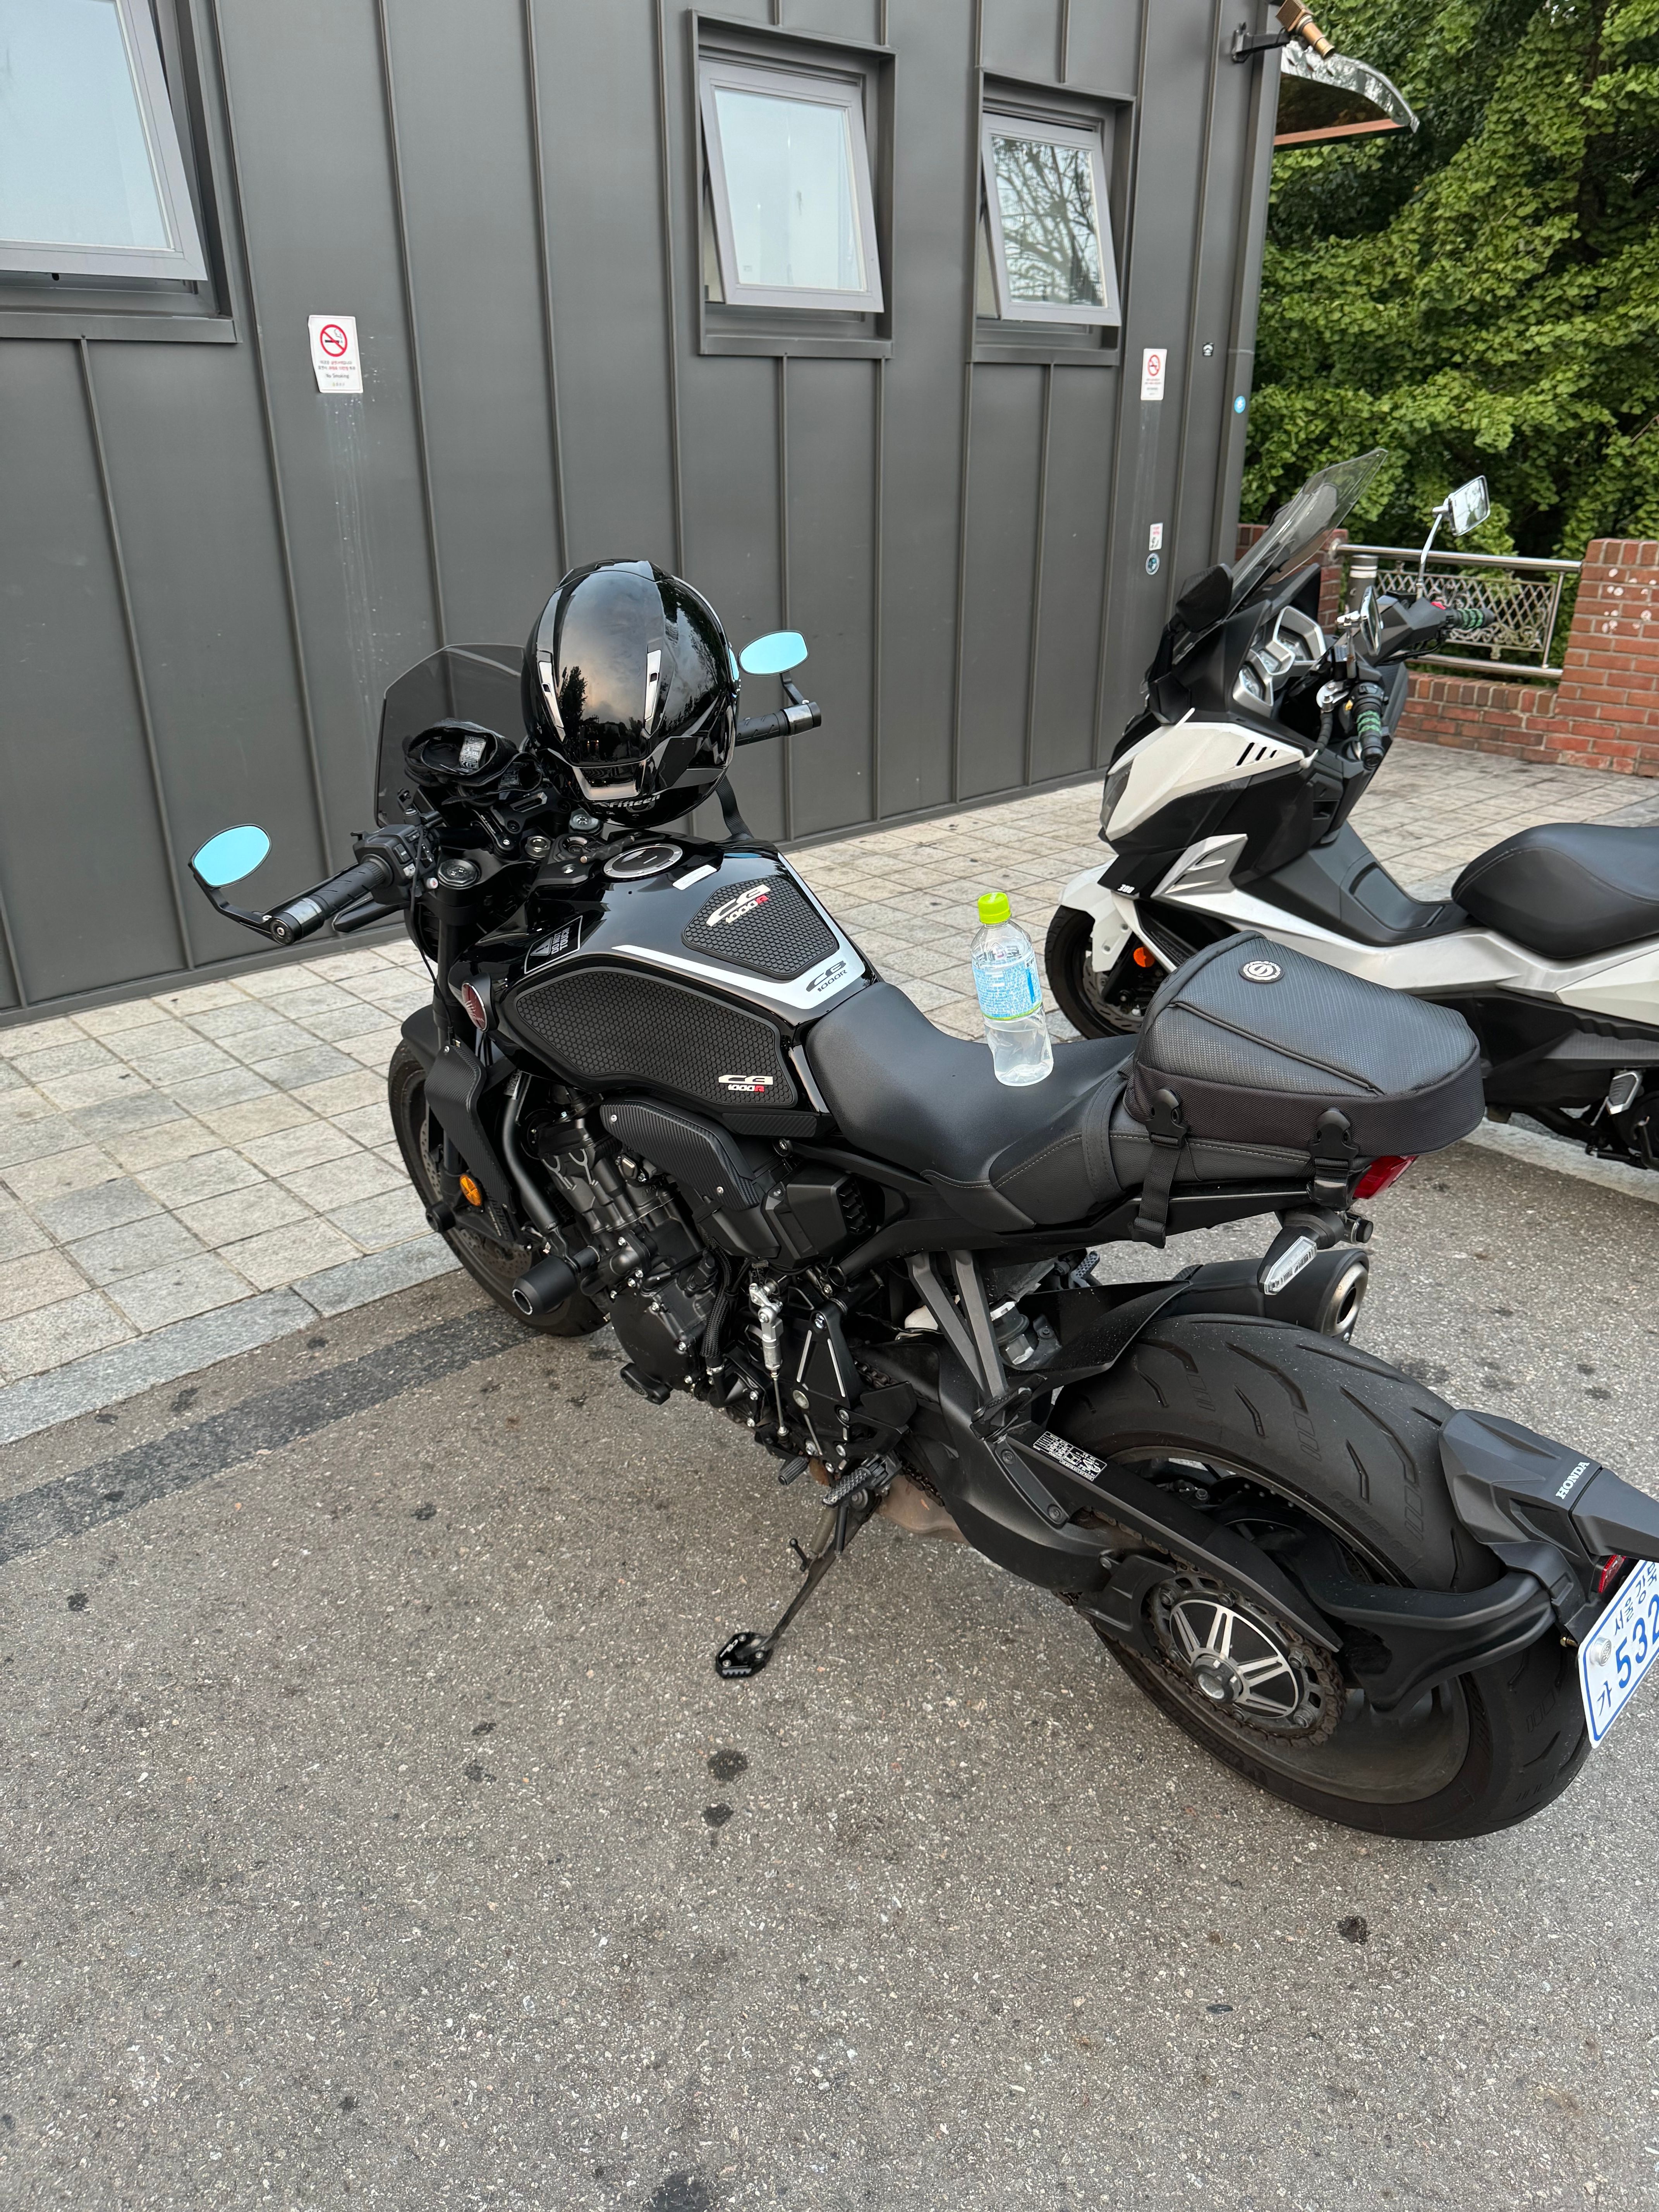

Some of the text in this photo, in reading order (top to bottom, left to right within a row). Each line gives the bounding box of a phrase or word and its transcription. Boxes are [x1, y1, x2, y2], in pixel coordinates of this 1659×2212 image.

[1117, 884, 1135, 893] 300
[706, 884, 771, 927] CB
[725, 895, 769, 924] 1000R
[551, 932, 562, 955] DO NOT
[560, 927, 570, 951] TOUCH
[806, 960, 847, 992] CB
[817, 970, 847, 992] 1000R
[718, 1075, 773, 1085] CB
[1555, 1462, 1590, 1499] HONDA
[1614, 1596, 1634, 1636] 서울
[1597, 1594, 1659, 1716] 가 532
